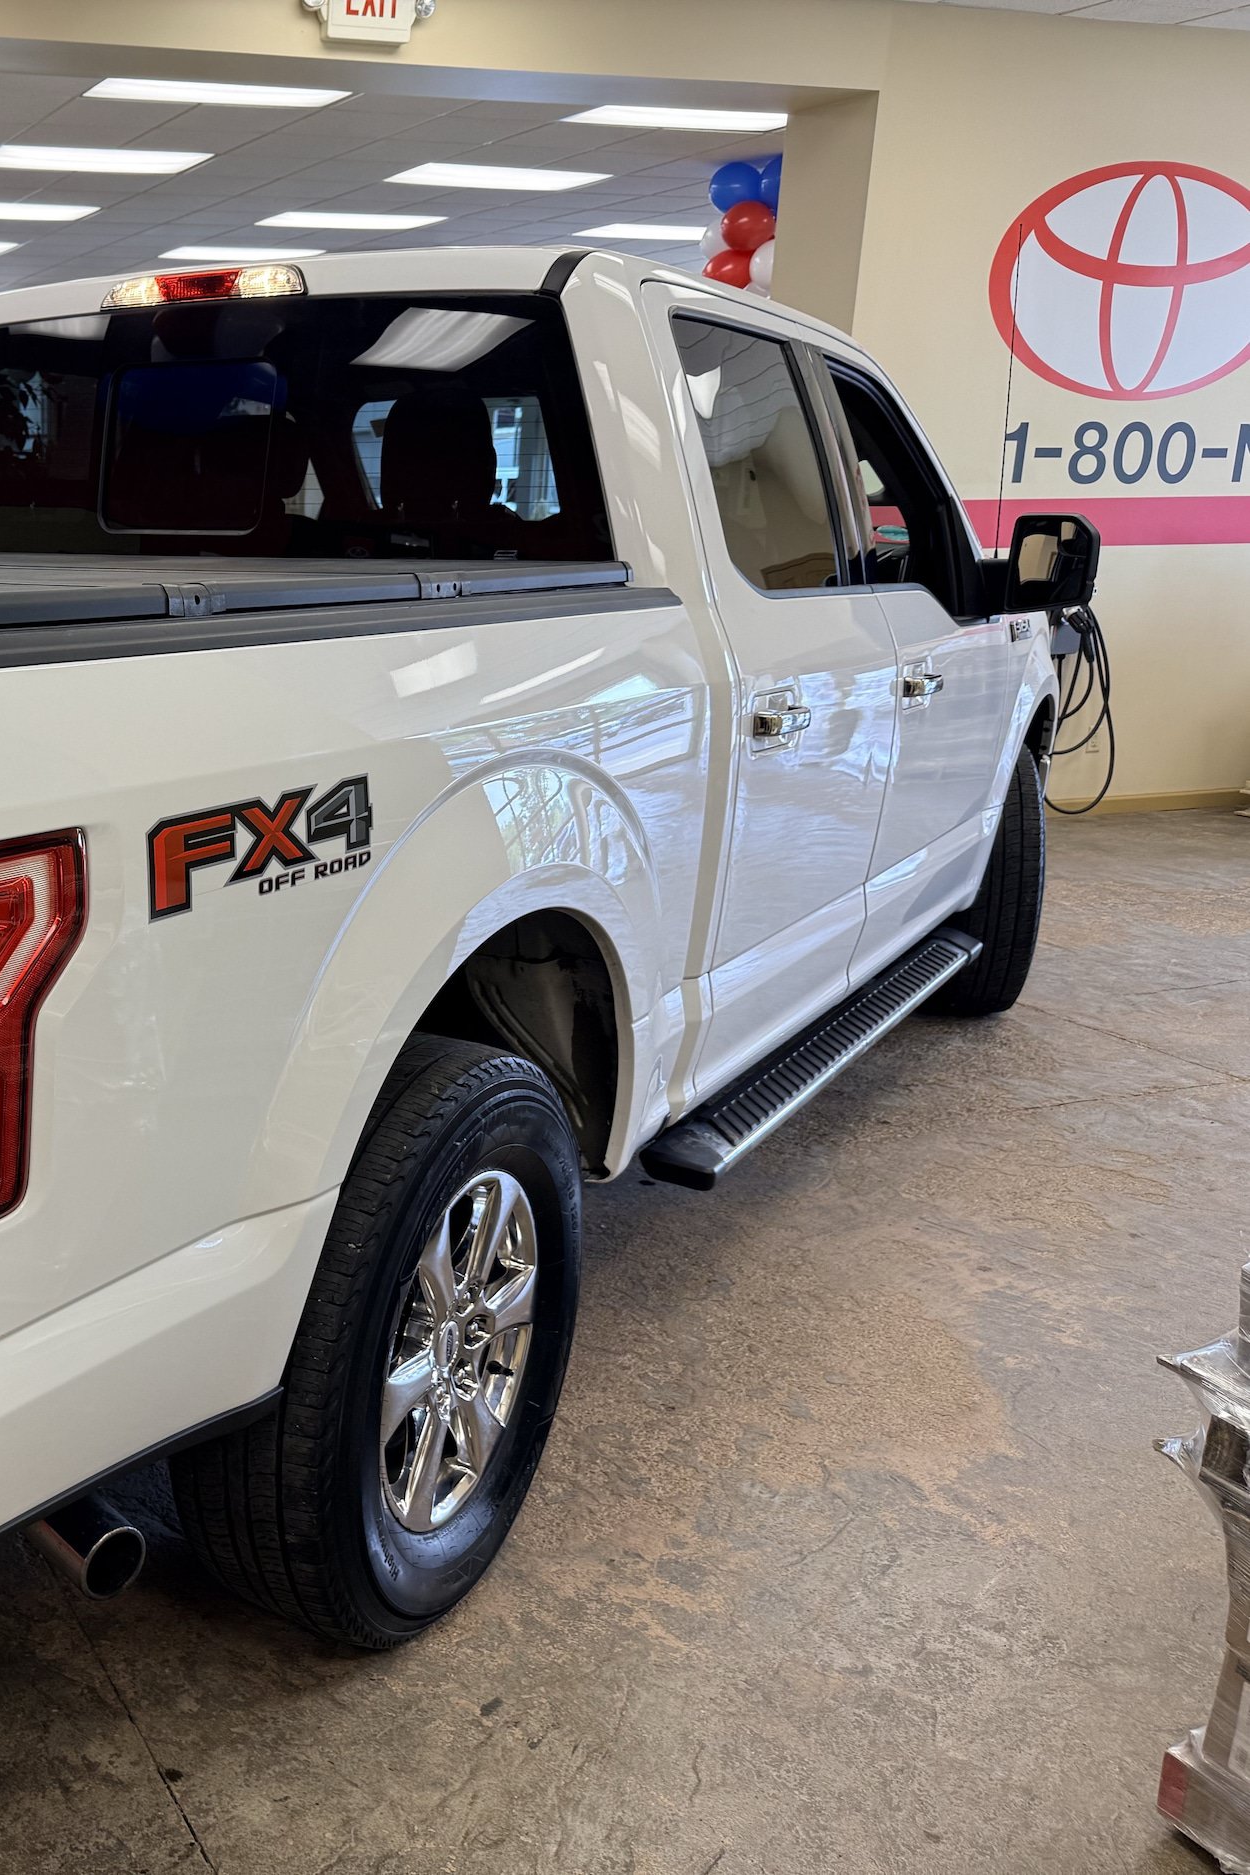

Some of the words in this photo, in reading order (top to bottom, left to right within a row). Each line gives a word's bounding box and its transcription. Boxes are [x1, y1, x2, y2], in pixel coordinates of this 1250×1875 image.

[146, 772, 373, 924] FX4
[258, 868, 305, 896] OFF
[313, 851, 371, 881] ROAD
